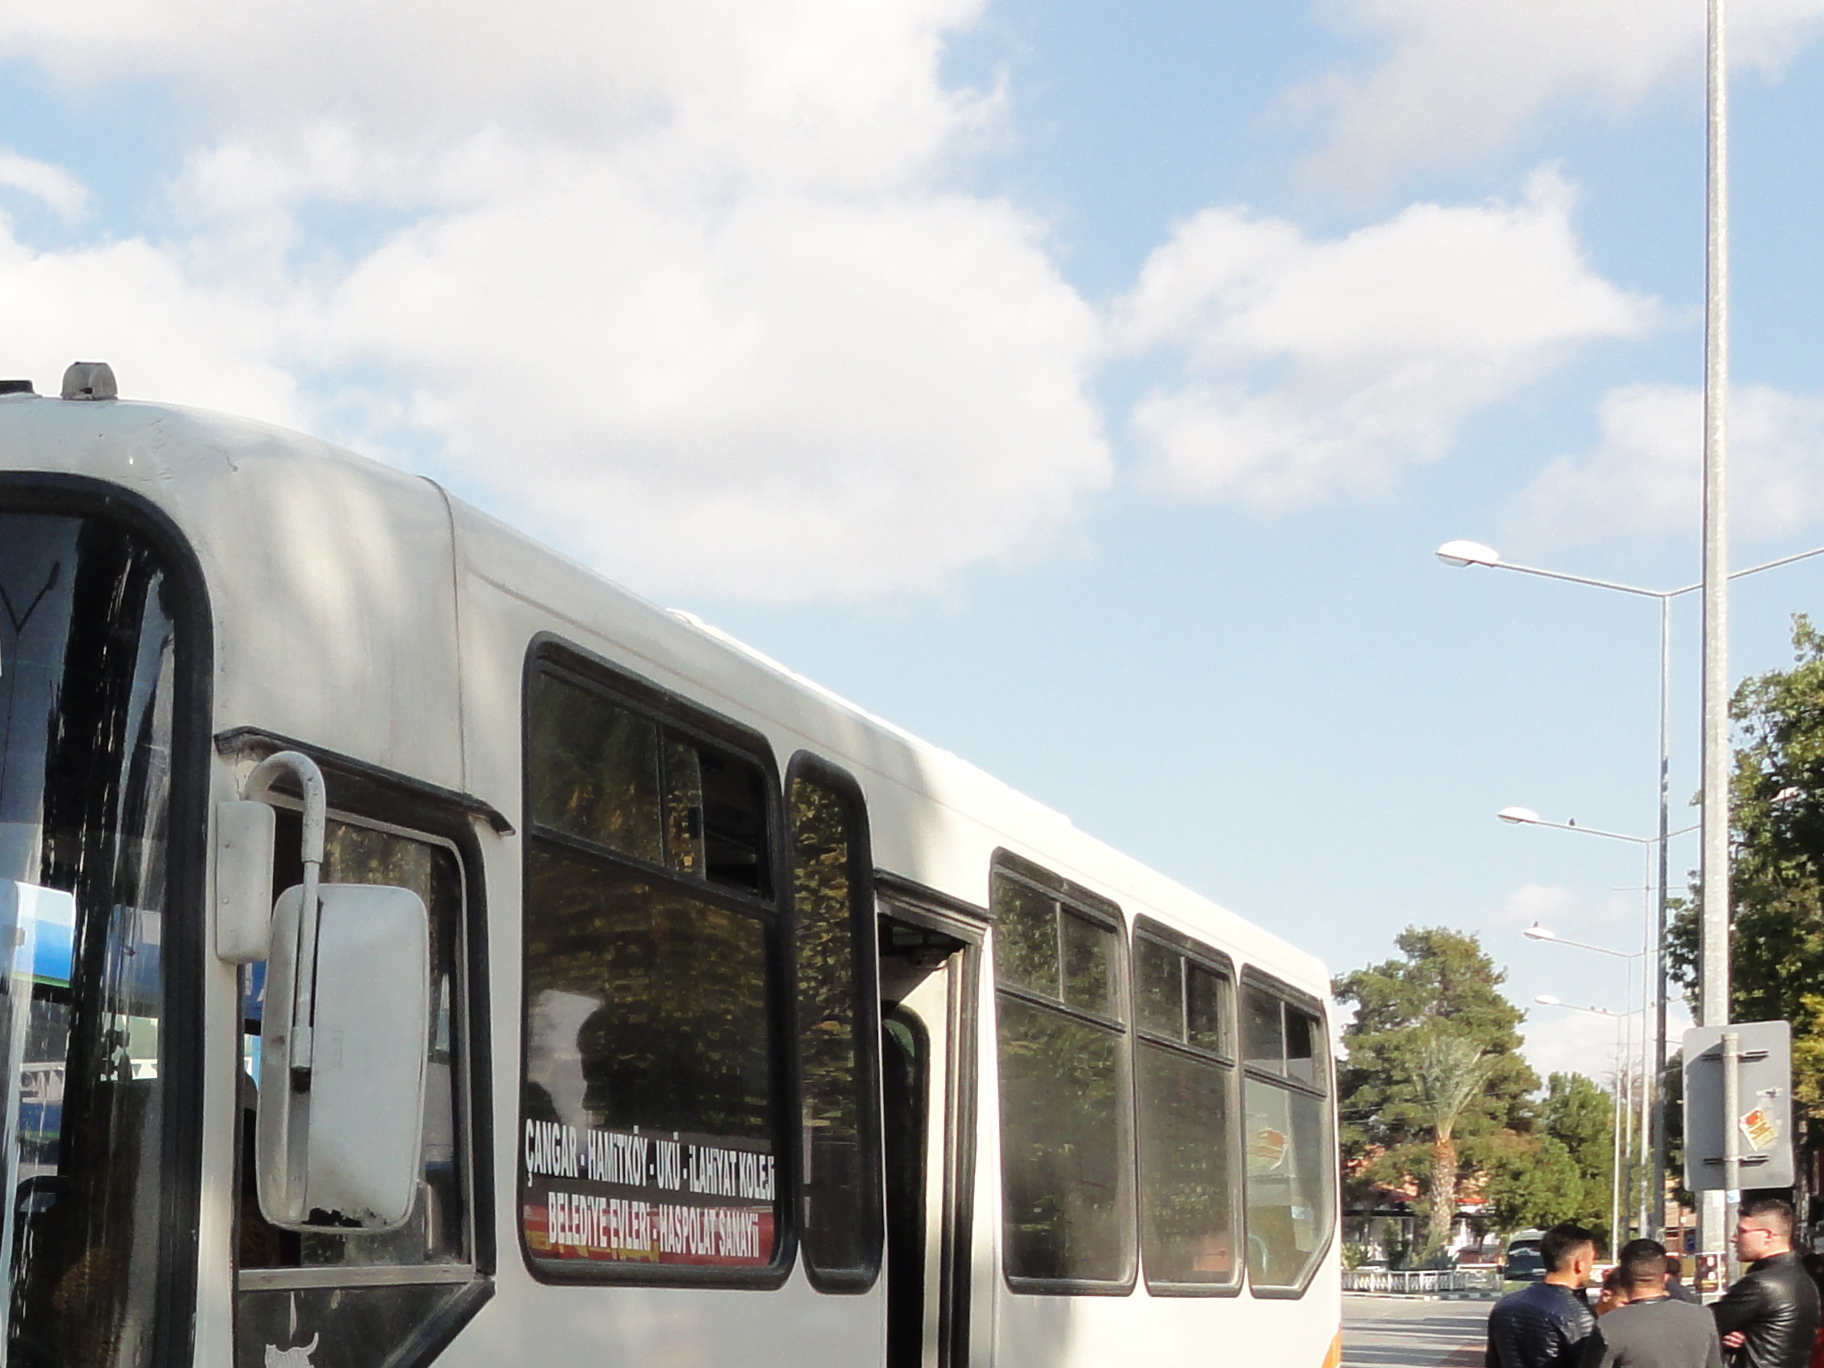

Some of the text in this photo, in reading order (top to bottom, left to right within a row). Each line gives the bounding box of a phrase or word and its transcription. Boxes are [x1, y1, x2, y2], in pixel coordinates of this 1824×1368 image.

[525, 1118, 578, 1188] ÇANGAR
[656, 1131, 681, 1191] UKÜ
[659, 1203, 716, 1256] HASPOLAT
